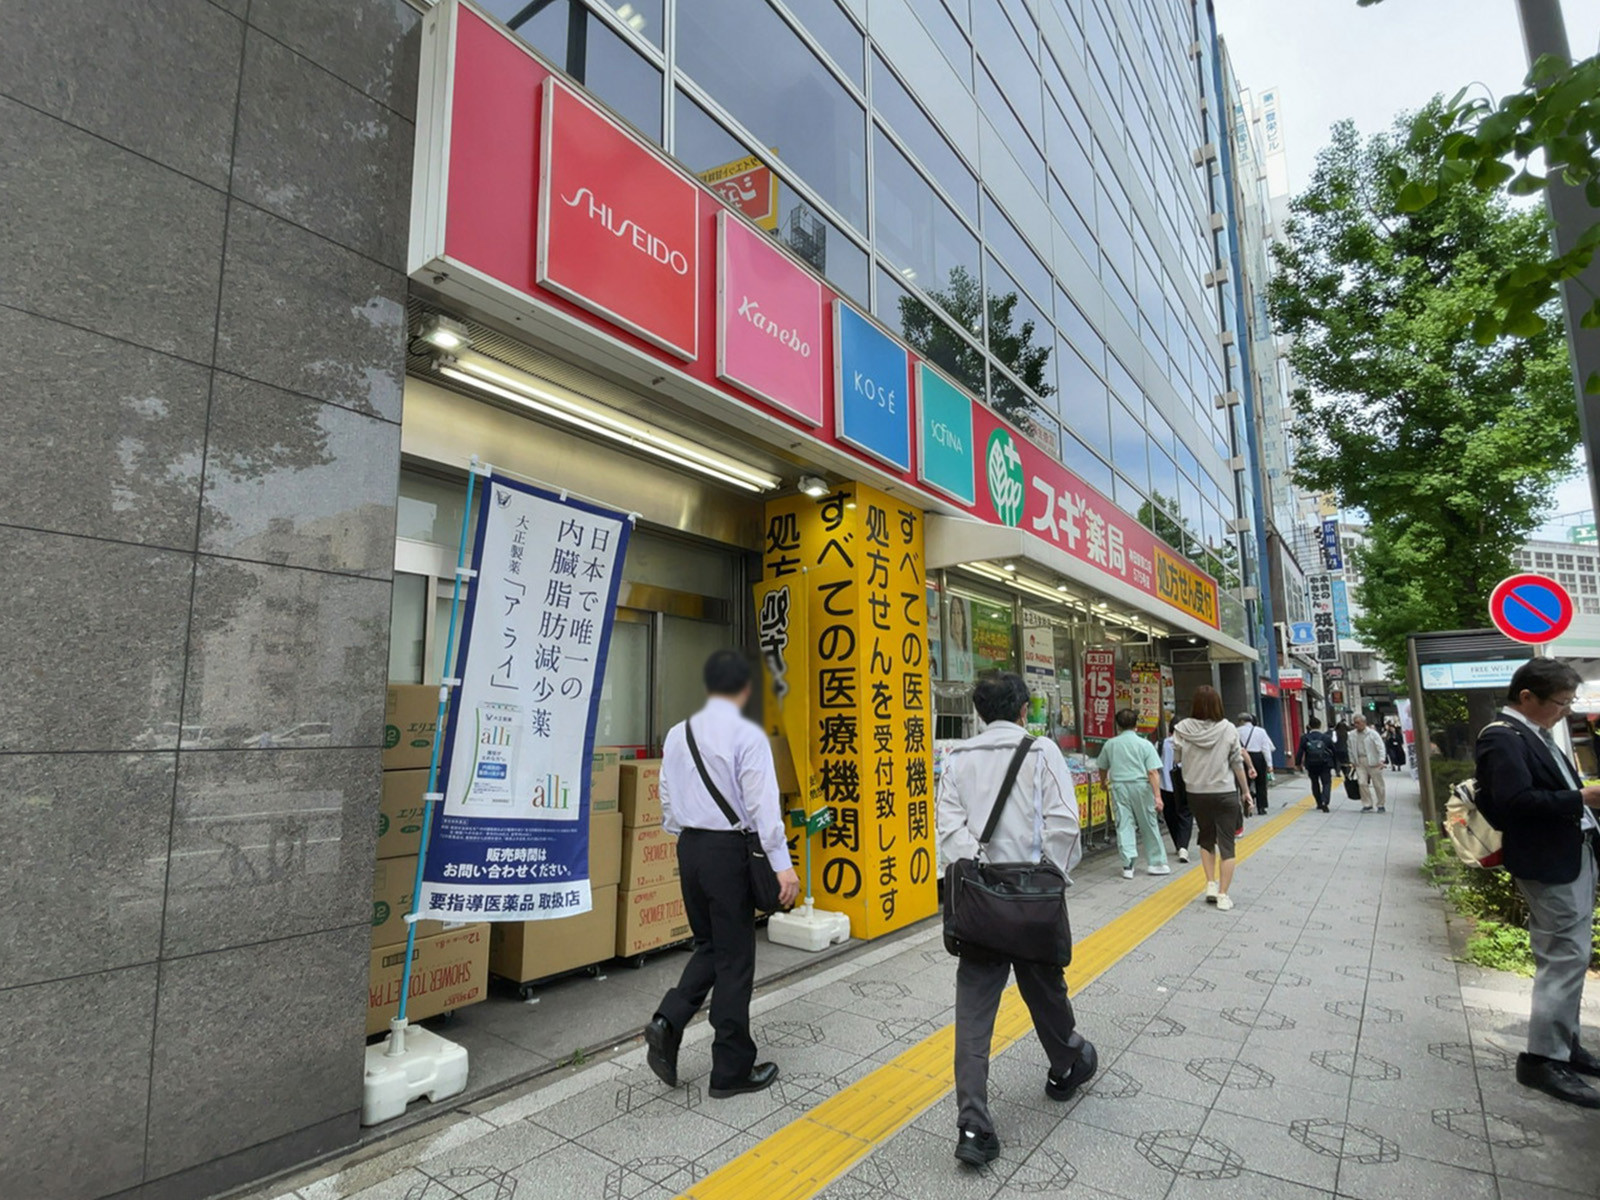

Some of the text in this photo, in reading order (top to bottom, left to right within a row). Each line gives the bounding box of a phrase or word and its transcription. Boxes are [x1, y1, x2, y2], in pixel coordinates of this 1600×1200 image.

[561, 188, 688, 275] SHISEIDO
[738, 296, 811, 357] Kanebo
[854, 370, 896, 414] KOSÉ
[931, 420, 964, 455] SOFINA
[508, 515, 530, 576] 大正製薬
[1032, 475, 1126, 576] スギ薬局
[1157, 552, 1213, 620] 処方せん受付
[531, 519, 585, 738] 内臓脂肪減少薬
[560, 527, 610, 700] 日本で唯一の
[1314, 612, 1337, 660] 筑前屋
[815, 490, 863, 900] すべての医療機関の
[897, 509, 931, 885] すべての医療機関の
[1087, 671, 1112, 698] 15
[866, 504, 899, 921] 処方せんを受付致します
[1094, 697, 1109, 735] 倍デー
[481, 726, 512, 747] alli
[531, 773, 571, 810] alli
[443, 862, 572, 879] お問い合わせください。
[485, 847, 547, 862] 販売時間は
[428, 891, 535, 913] 要指導医薬品
[538, 890, 581, 910] 取扱店
[640, 902, 664, 927] SHOWER
[384, 972, 428, 1005] TOIET
[430, 960, 472, 992] SHOWER
